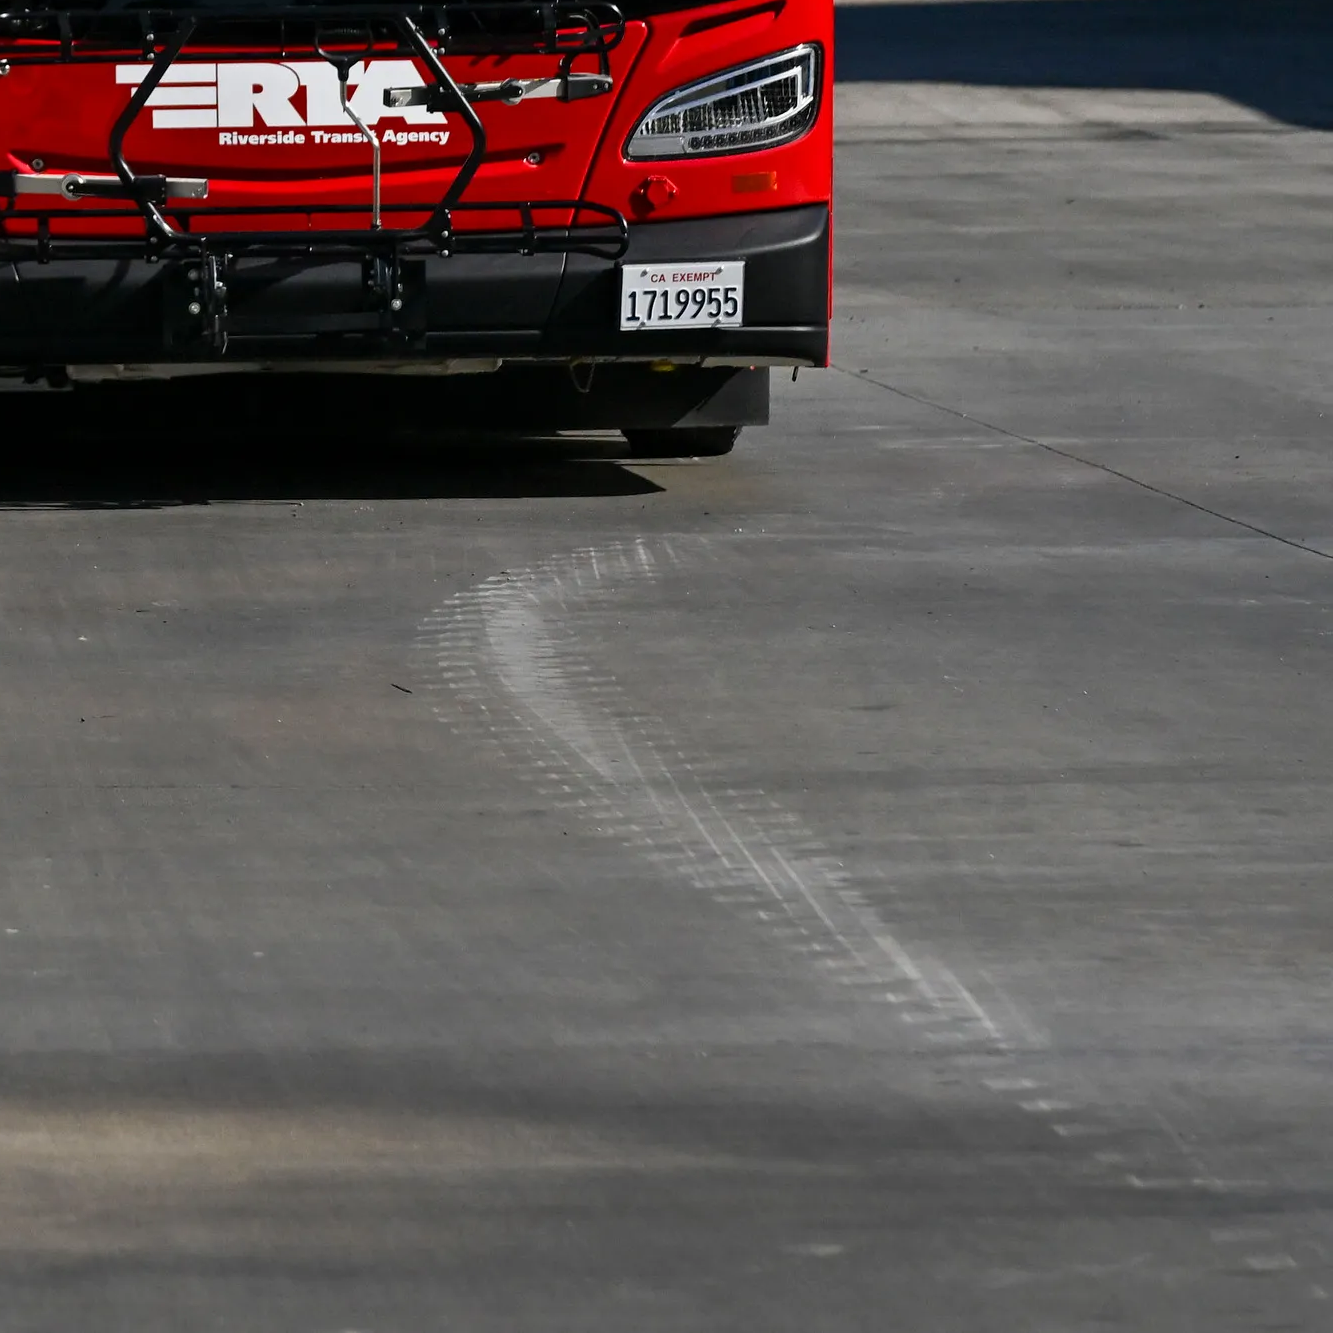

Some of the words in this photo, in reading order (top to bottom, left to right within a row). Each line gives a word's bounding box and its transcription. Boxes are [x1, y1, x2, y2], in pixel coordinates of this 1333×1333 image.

[217, 60, 448, 127] RTA
[218, 131, 306, 145] Riverside
[382, 130, 450, 146] Agency
[650, 274, 666, 282] CA
[672, 272, 716, 282] EXEMPT
[626, 287, 738, 321] 1719955
